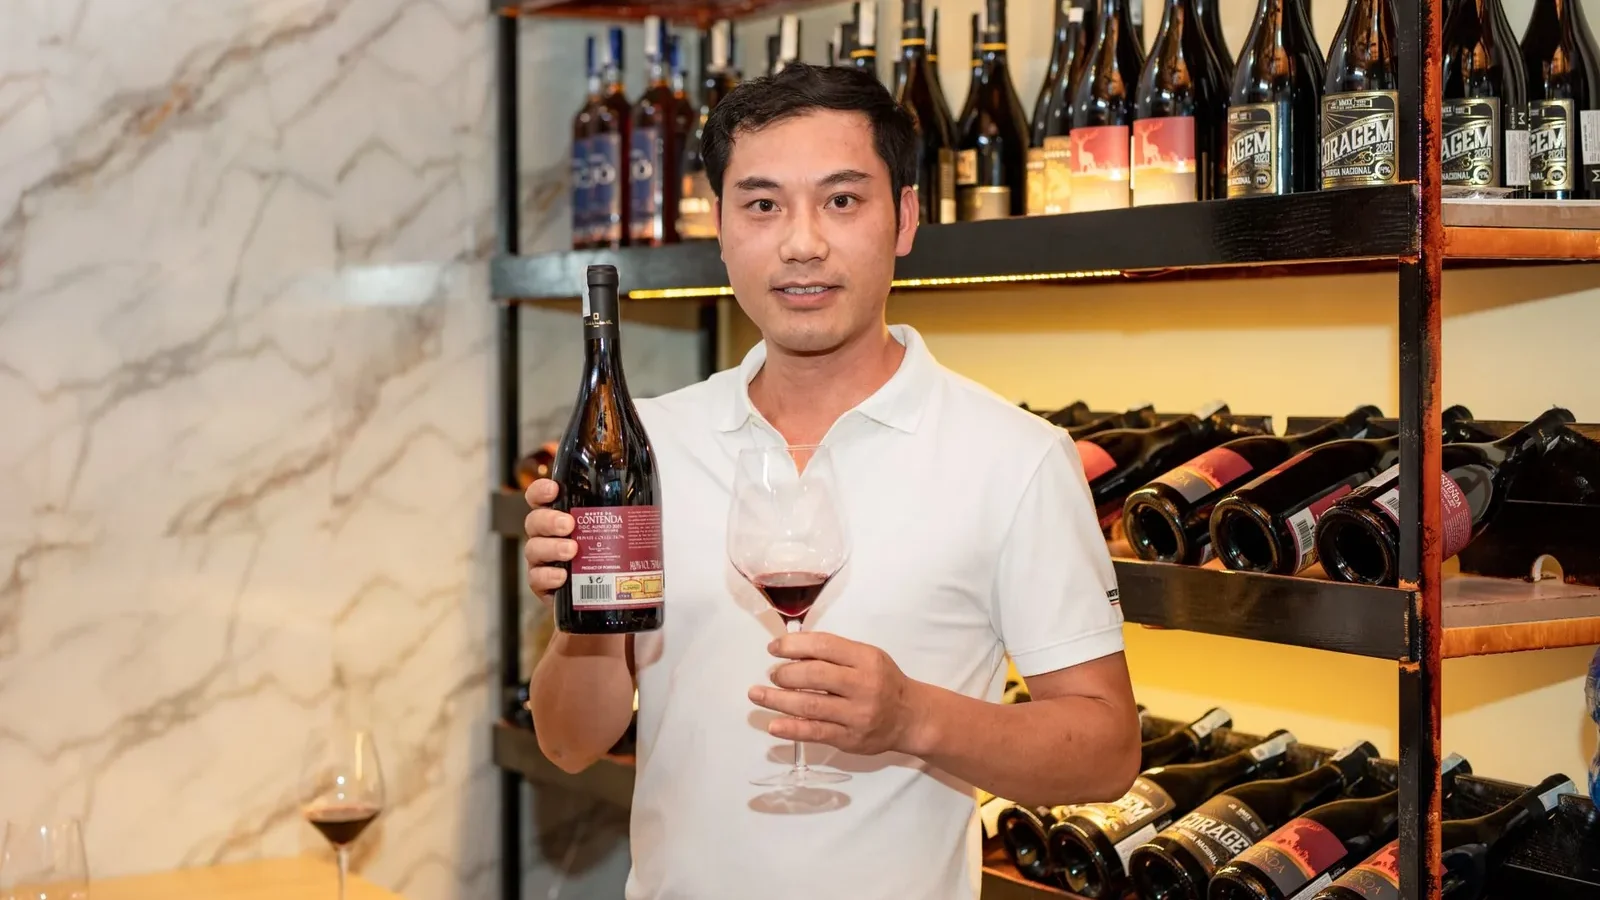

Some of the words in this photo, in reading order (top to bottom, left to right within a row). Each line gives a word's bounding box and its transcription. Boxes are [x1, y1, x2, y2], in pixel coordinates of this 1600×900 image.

[1229, 130, 1271, 168] AGEM
[1375, 141, 1393, 154] 2020
[1474, 147, 1492, 158] 2020
[1253, 152, 1271, 164] 2020
[1547, 149, 1566, 160] 2020
[1341, 166, 1372, 176] NACIONAL
[577, 514, 624, 525] CONTENDA
